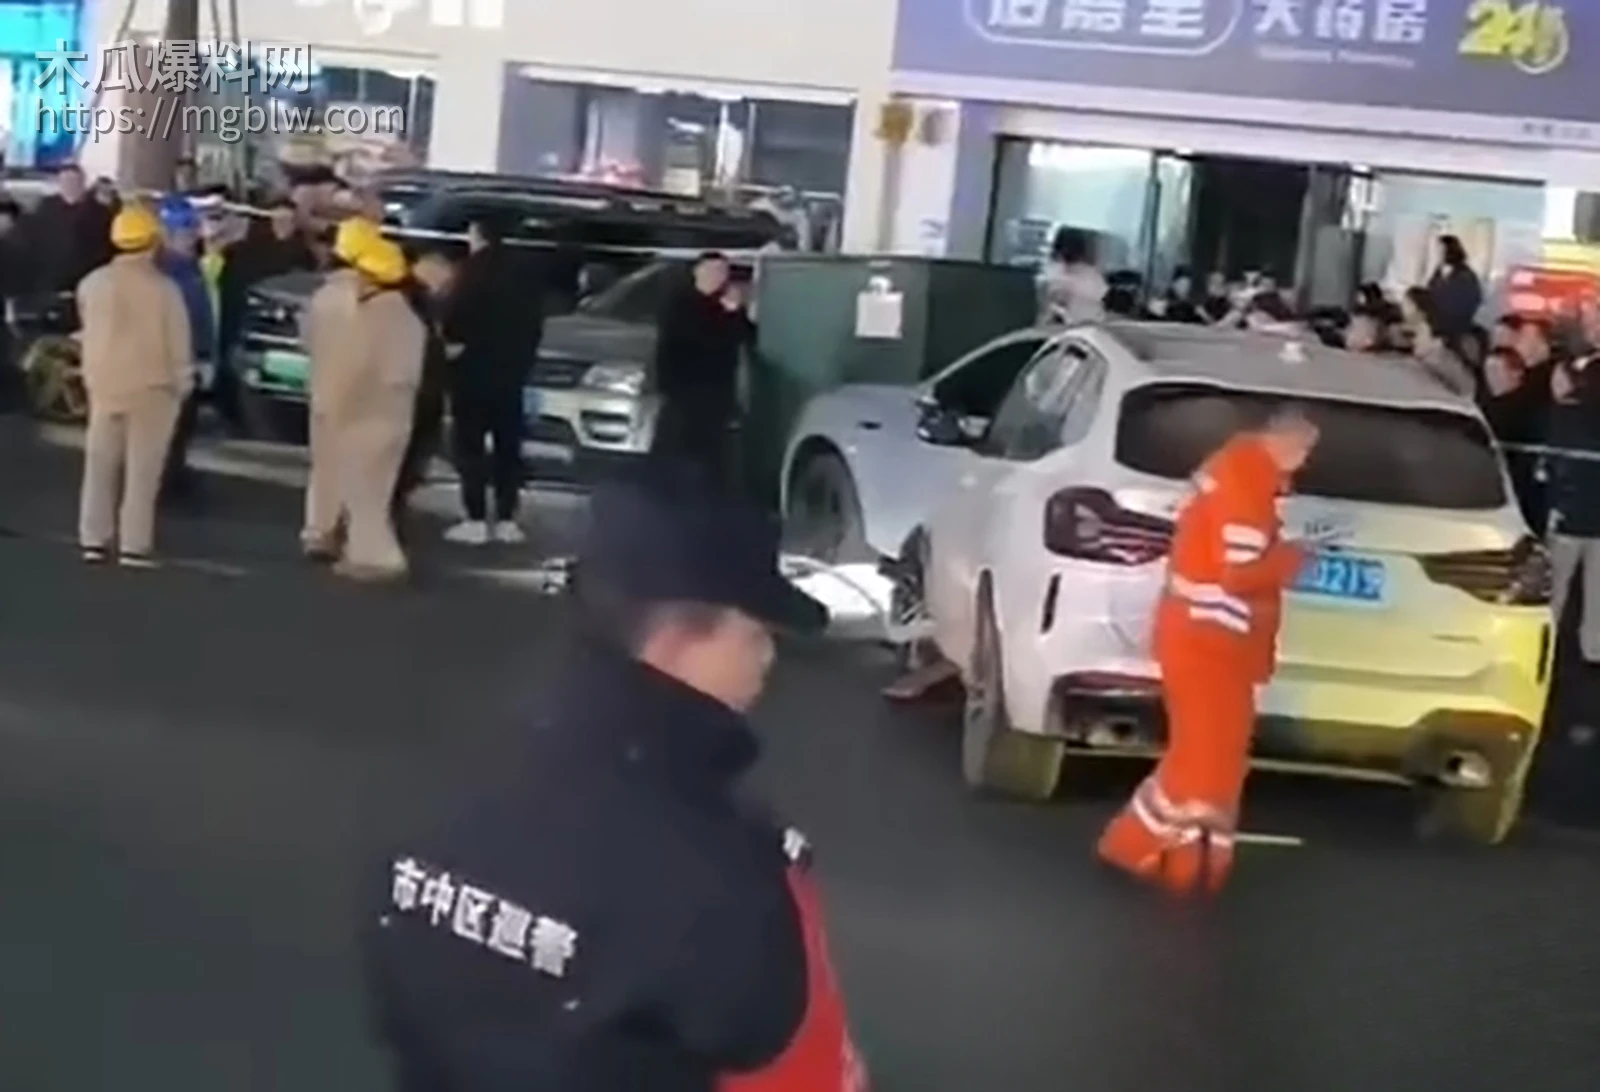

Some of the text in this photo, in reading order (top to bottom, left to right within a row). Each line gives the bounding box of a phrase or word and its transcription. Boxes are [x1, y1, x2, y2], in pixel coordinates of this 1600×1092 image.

[392, 858, 579, 978] 市中区巡警
